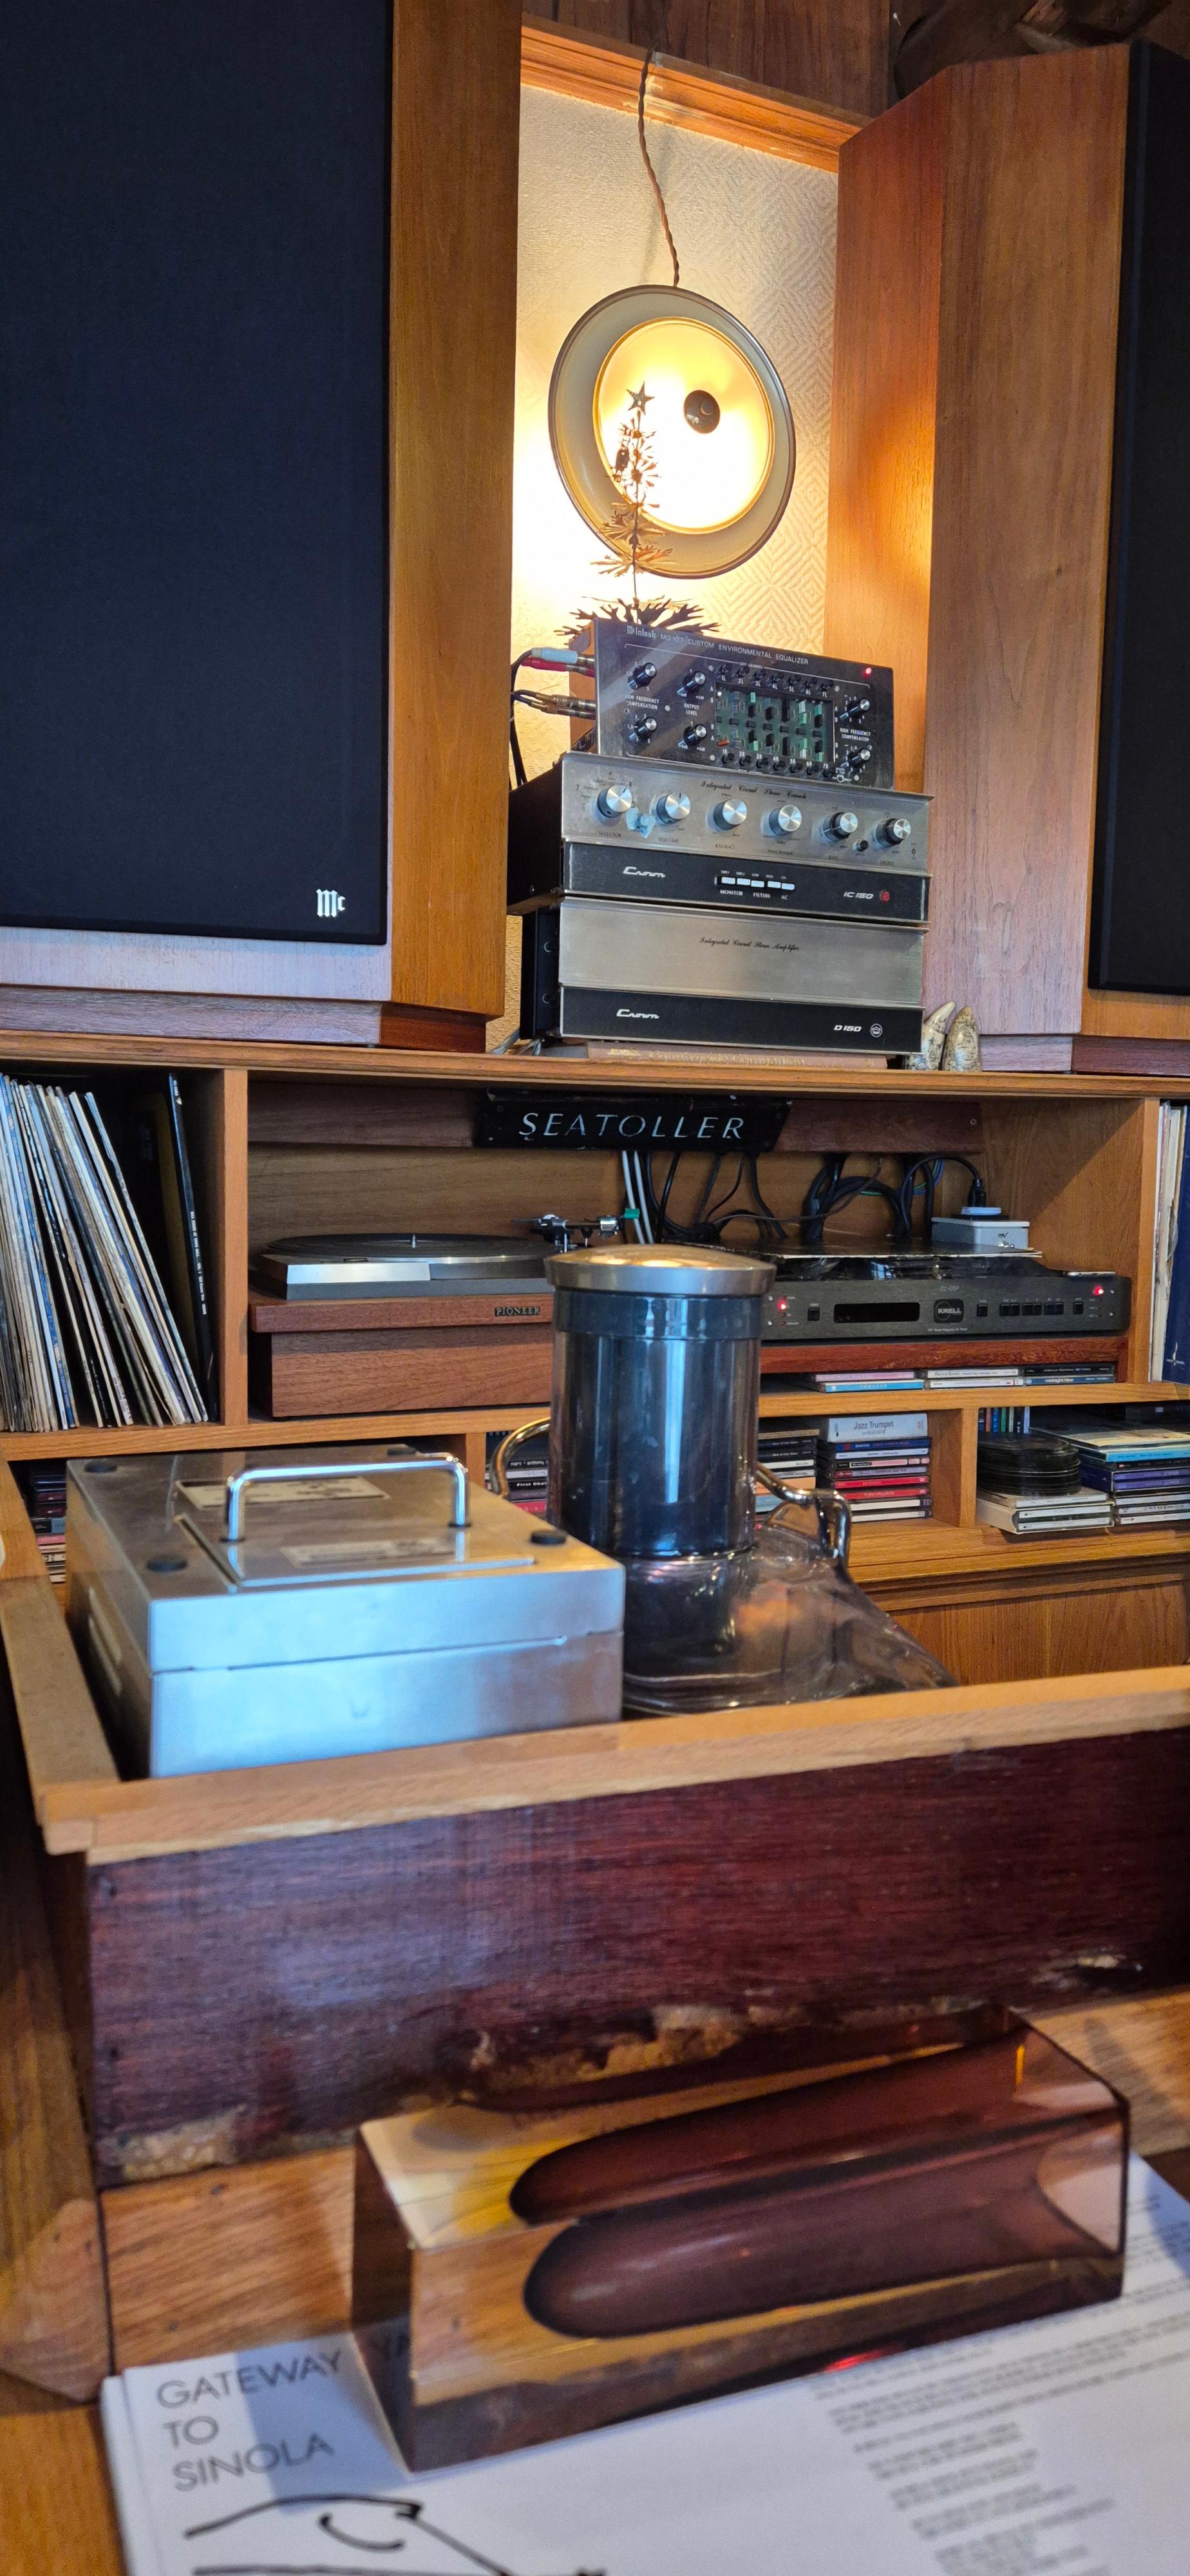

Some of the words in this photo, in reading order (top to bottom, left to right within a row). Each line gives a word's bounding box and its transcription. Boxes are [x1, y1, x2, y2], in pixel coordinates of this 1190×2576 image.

[627, 625, 656, 639] McIntosh
[688, 638, 715, 648] CUSTOM
[718, 643, 772, 659] ENVIRONMENTAL
[775, 654, 809, 665] EQUALIZER
[626, 700, 658, 710] COMPENSATION
[701, 781, 732, 791] Integrated
[738, 784, 758, 793] Circuit
[763, 788, 781, 796] Stereo
[786, 790, 807, 799] Console
[623, 866, 666, 878] Crown
[699, 936, 730, 947] Integrated
[733, 938, 751, 947] Circuit
[771, 943, 799, 953] Amplifier
[616, 1009, 659, 1019] Crown
[518, 1112, 744, 1139] SEATOLLER
[496, 1307, 540, 1315] PIONEER
[869, 1420, 894, 1429] Trumpet
[157, 2349, 341, 2409] GATEWAY
[163, 2416, 219, 2448] TO
[173, 2432, 335, 2492] SINOLA
